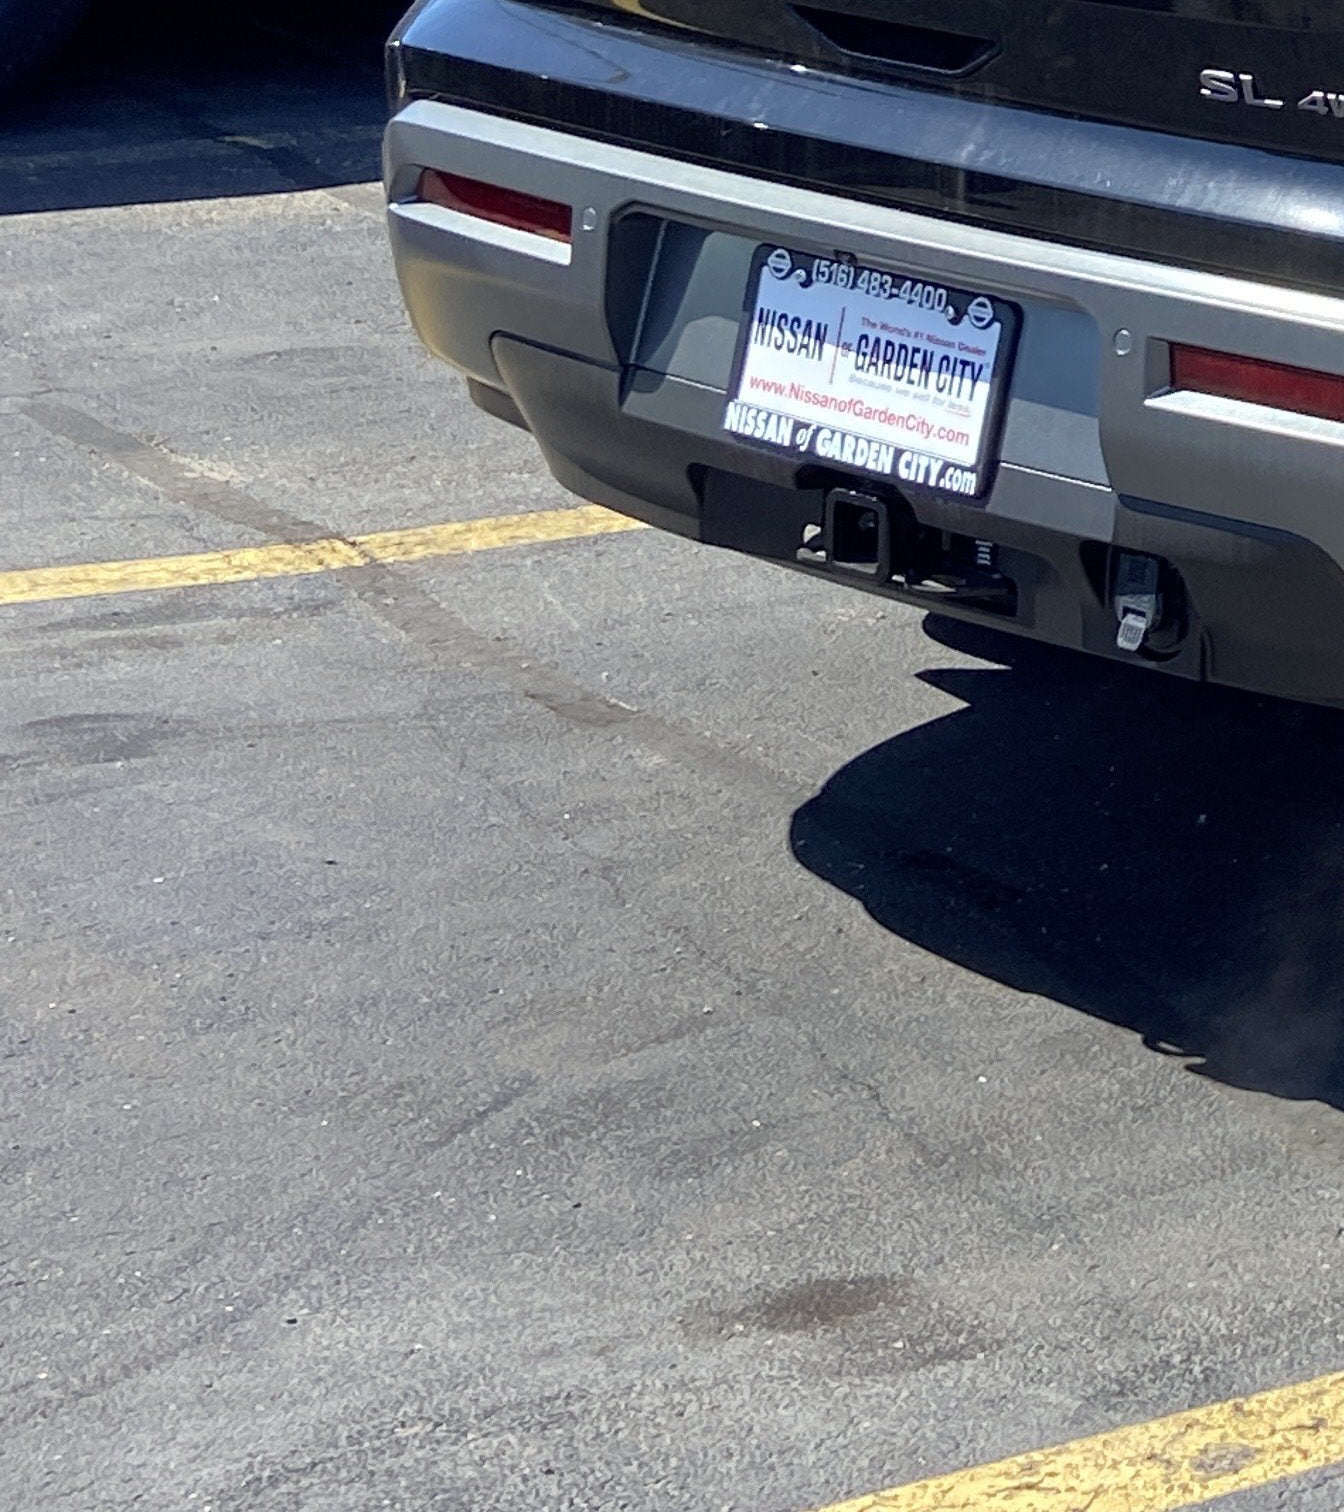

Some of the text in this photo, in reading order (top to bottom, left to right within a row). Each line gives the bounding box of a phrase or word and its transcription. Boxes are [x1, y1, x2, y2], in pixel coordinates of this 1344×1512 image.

[1200, 68, 1284, 109] SL
[812, 257, 948, 313] (516) 483-4400
[754, 306, 829, 362] NISSAN
[854, 333, 935, 390] GARDEN
[936, 354, 984, 402] CITY
[749, 375, 970, 447] www.NissanofGardenCity.com
[724, 401, 977, 496] NISSAN of GARDEN CITY.com
